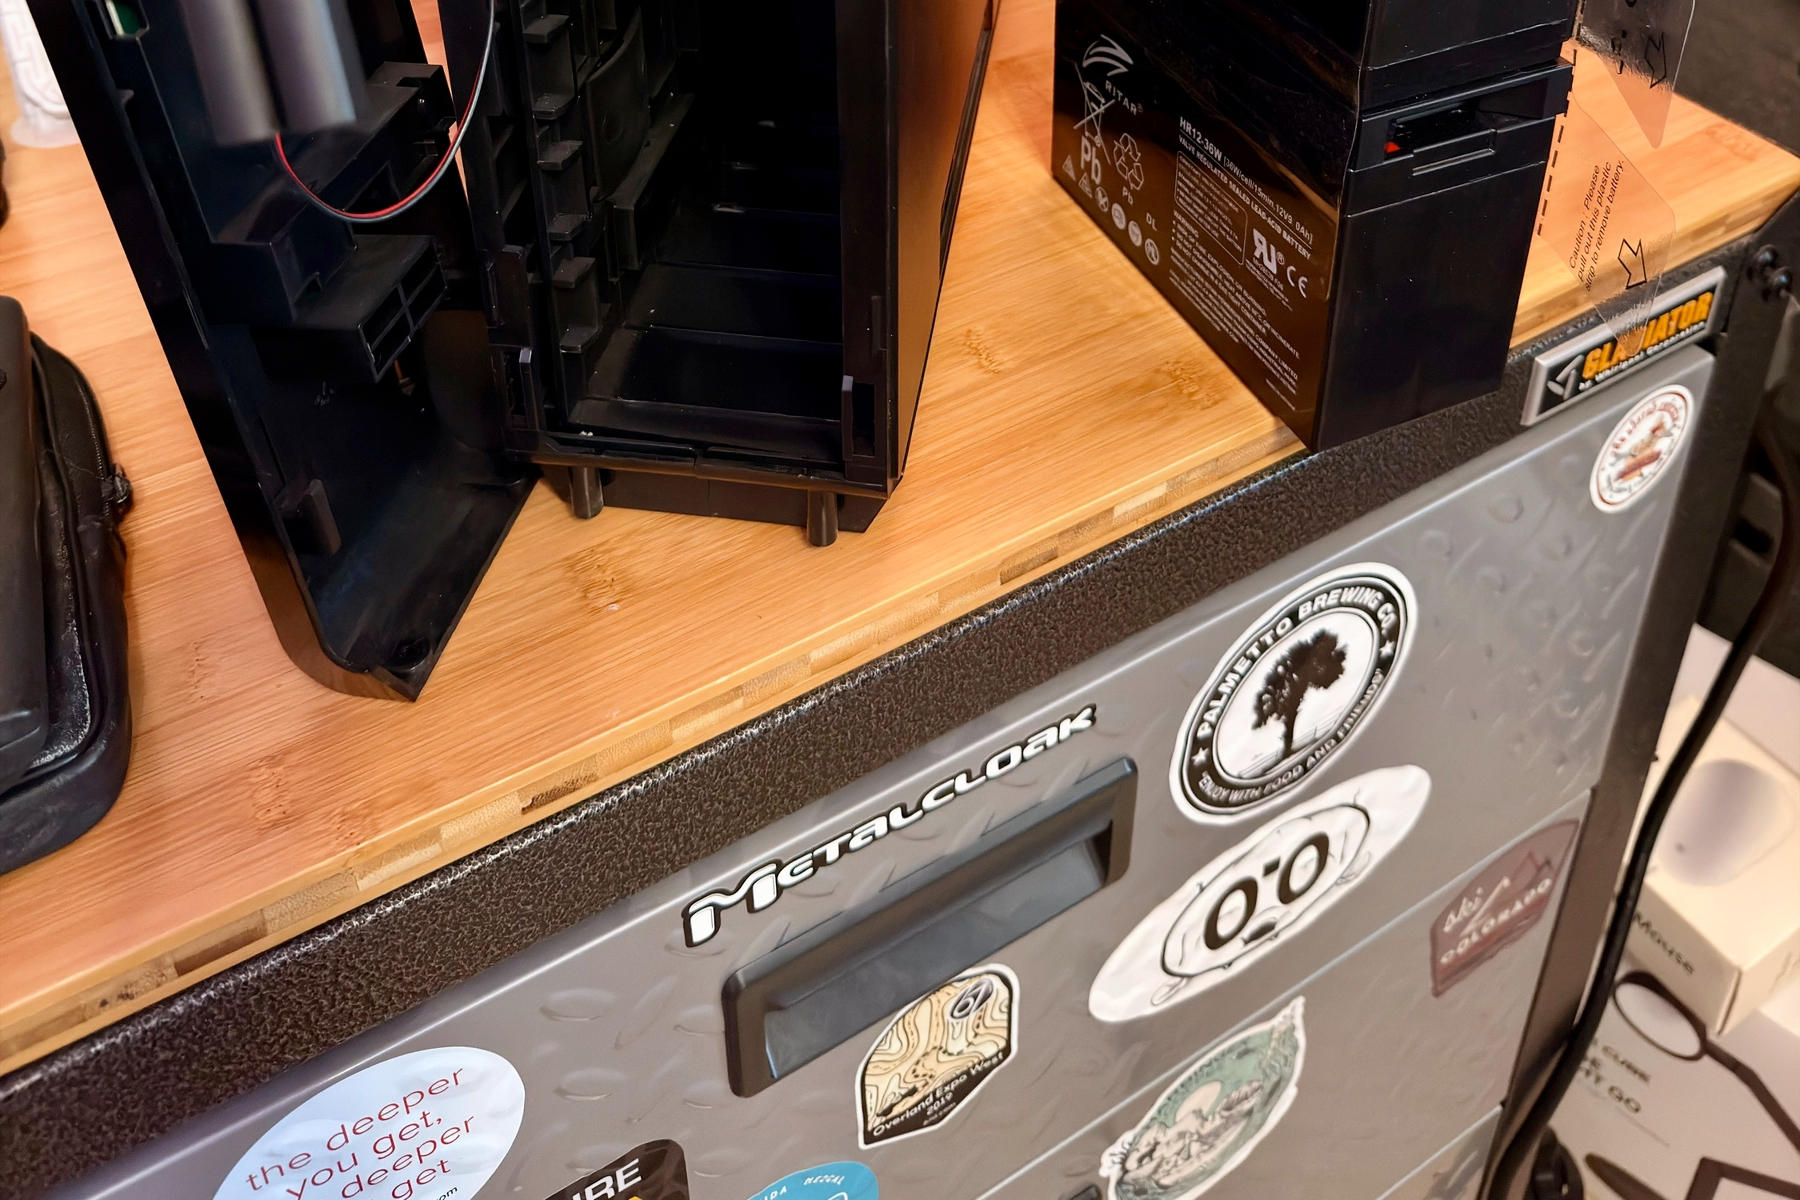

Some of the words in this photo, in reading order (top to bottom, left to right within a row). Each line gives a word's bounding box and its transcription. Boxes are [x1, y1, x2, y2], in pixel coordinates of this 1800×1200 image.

[1081, 135, 1101, 185] Pb
[1179, 115, 1222, 163] HR12-36W
[1122, 186, 1134, 205] Pb
[1146, 212, 1158, 231] DL
[1178, 133, 1195, 155] VALVE
[1196, 149, 1227, 185] REGULATED
[1228, 179, 1250, 206] SEALED
[1250, 199, 1281, 234] LEAD-ACID
[1282, 228, 1311, 261] BATTERY
[1570, 218, 1587, 269] Caution
[1583, 165, 1600, 211] Please
[1577, 256, 1588, 283] pull
[1584, 231, 1594, 254] out
[1589, 208, 1600, 233] this
[1596, 162, 1612, 208] plastic
[1593, 254, 1600, 266] to
[1595, 206, 1611, 252] remove
[1585, 265, 1597, 292] strip
[1196, 617, 1294, 738] PALMETTO
[1298, 586, 1385, 621] BREWING
[1228, 786, 1261, 803] WITH
[1263, 765, 1304, 795] FOOD
[1305, 738, 1337, 769] AND
[1440, 878, 1552, 964] COLORADO
[873, 1095, 933, 1136] Overland
[935, 1074, 968, 1101] Expo
[969, 1053, 1005, 1076] West
[926, 1092, 954, 1116] 2019
[245, 1152, 312, 1192] the
[326, 1067, 463, 1151] deeper
[287, 1152, 359, 1200] you
[373, 1110, 443, 1160] get,
[341, 1116, 474, 1200] deeper
[391, 1159, 451, 1200] get
